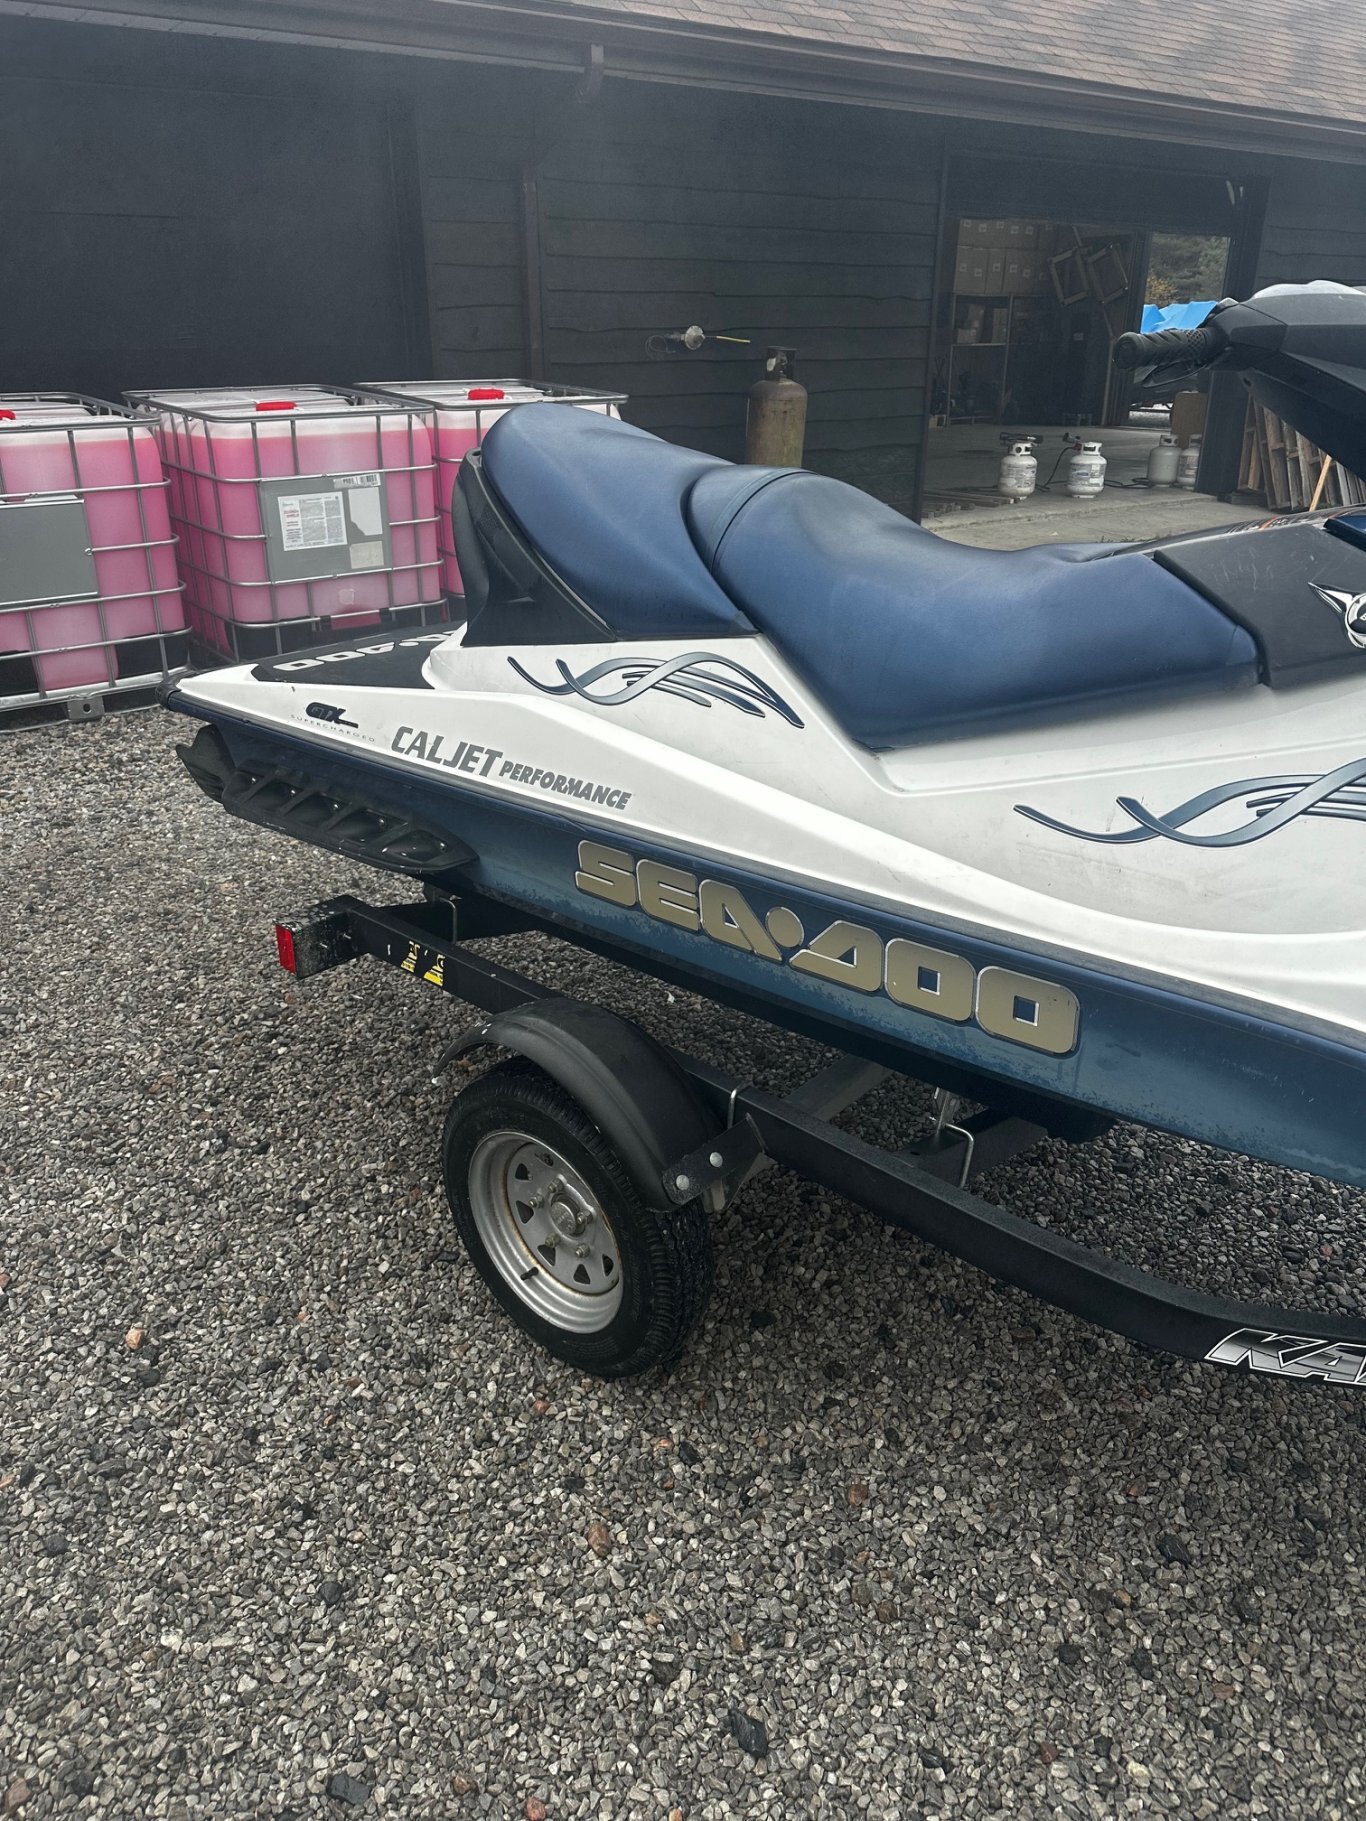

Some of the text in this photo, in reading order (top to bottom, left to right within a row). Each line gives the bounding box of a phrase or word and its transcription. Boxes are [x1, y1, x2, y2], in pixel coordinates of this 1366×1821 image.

[290, 714, 375, 743] SUPERCHARGED
[391, 726, 632, 810] CALJET PERFORMANCE
[1204, 1328, 1366, 1386] KA
